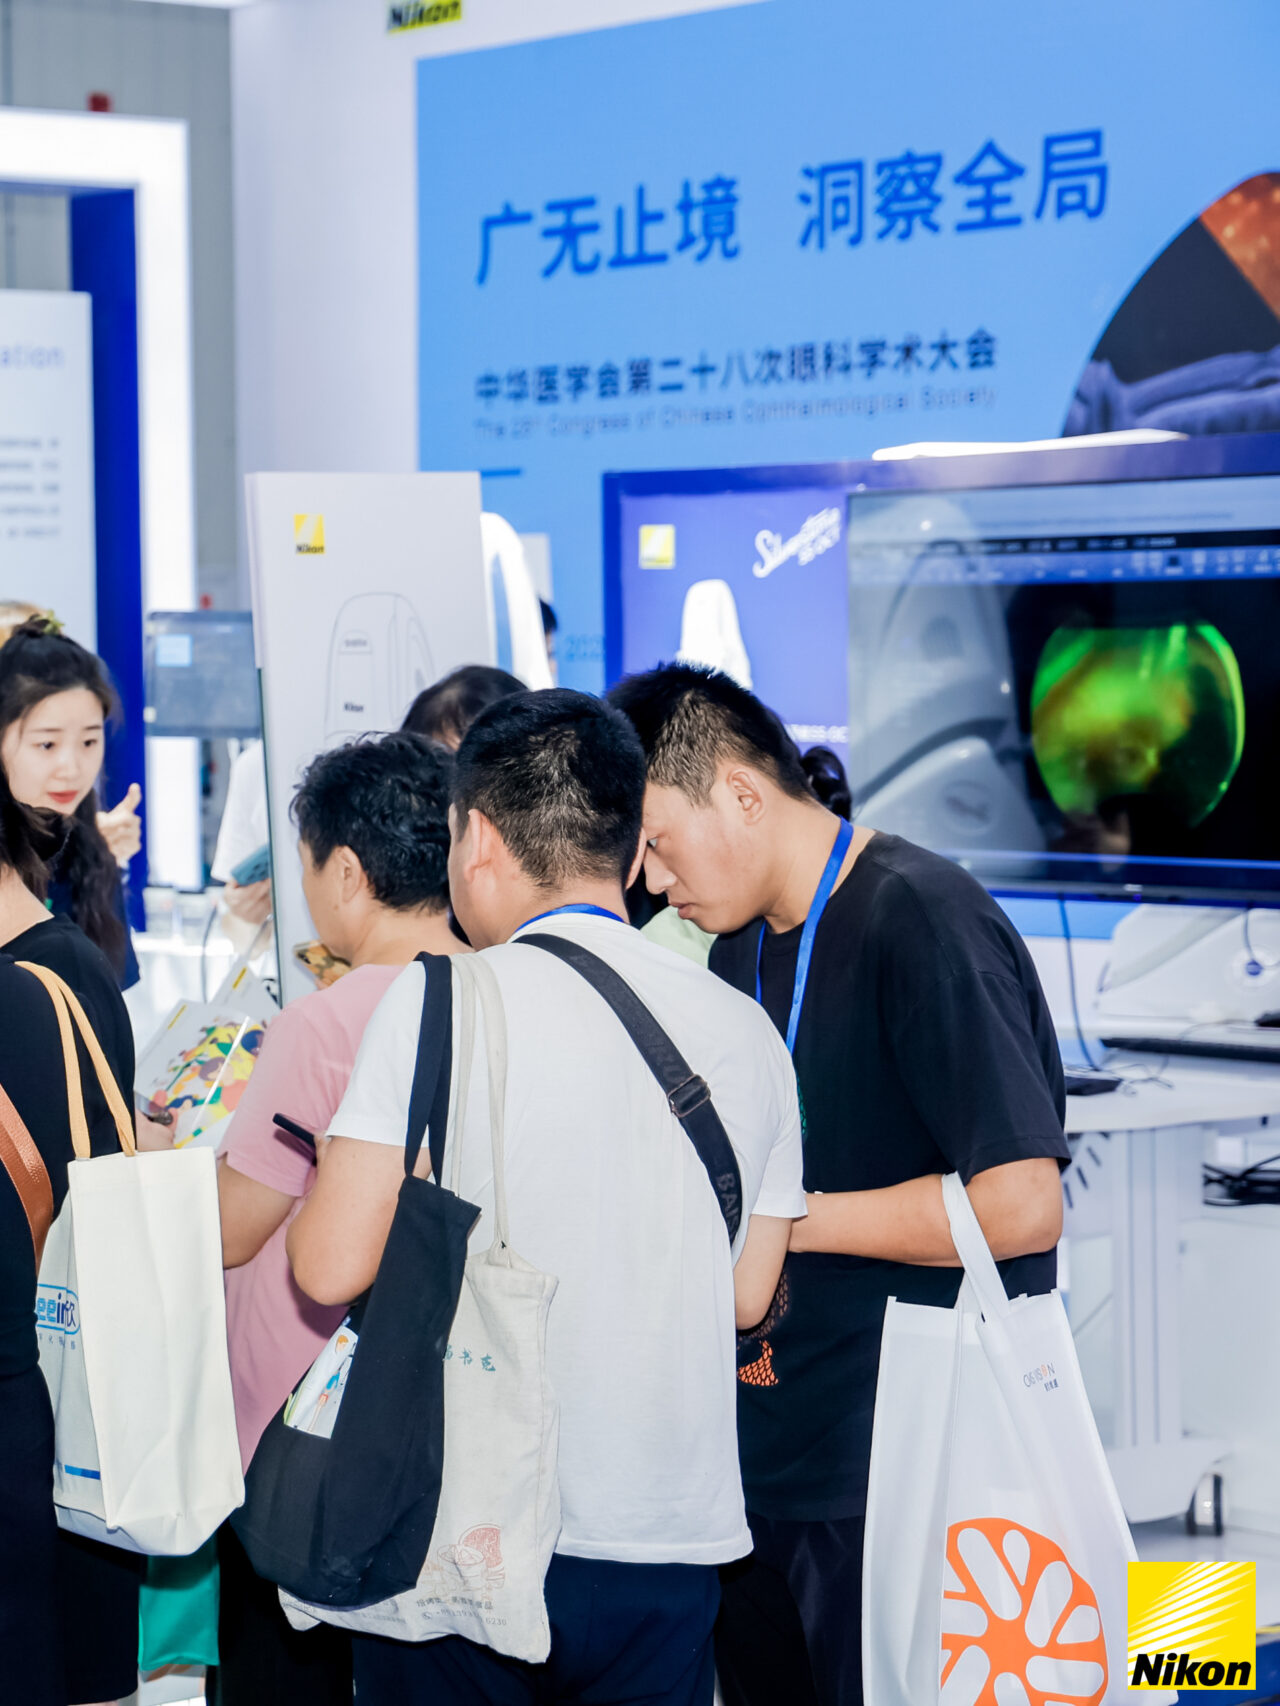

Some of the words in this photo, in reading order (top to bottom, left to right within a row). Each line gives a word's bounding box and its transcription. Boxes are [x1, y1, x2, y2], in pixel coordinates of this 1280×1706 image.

[475, 174, 741, 287] 广无止境
[798, 128, 1110, 251] 洞察全局
[475, 327, 998, 409] 中华医学会第二十八次眼科学术大会
